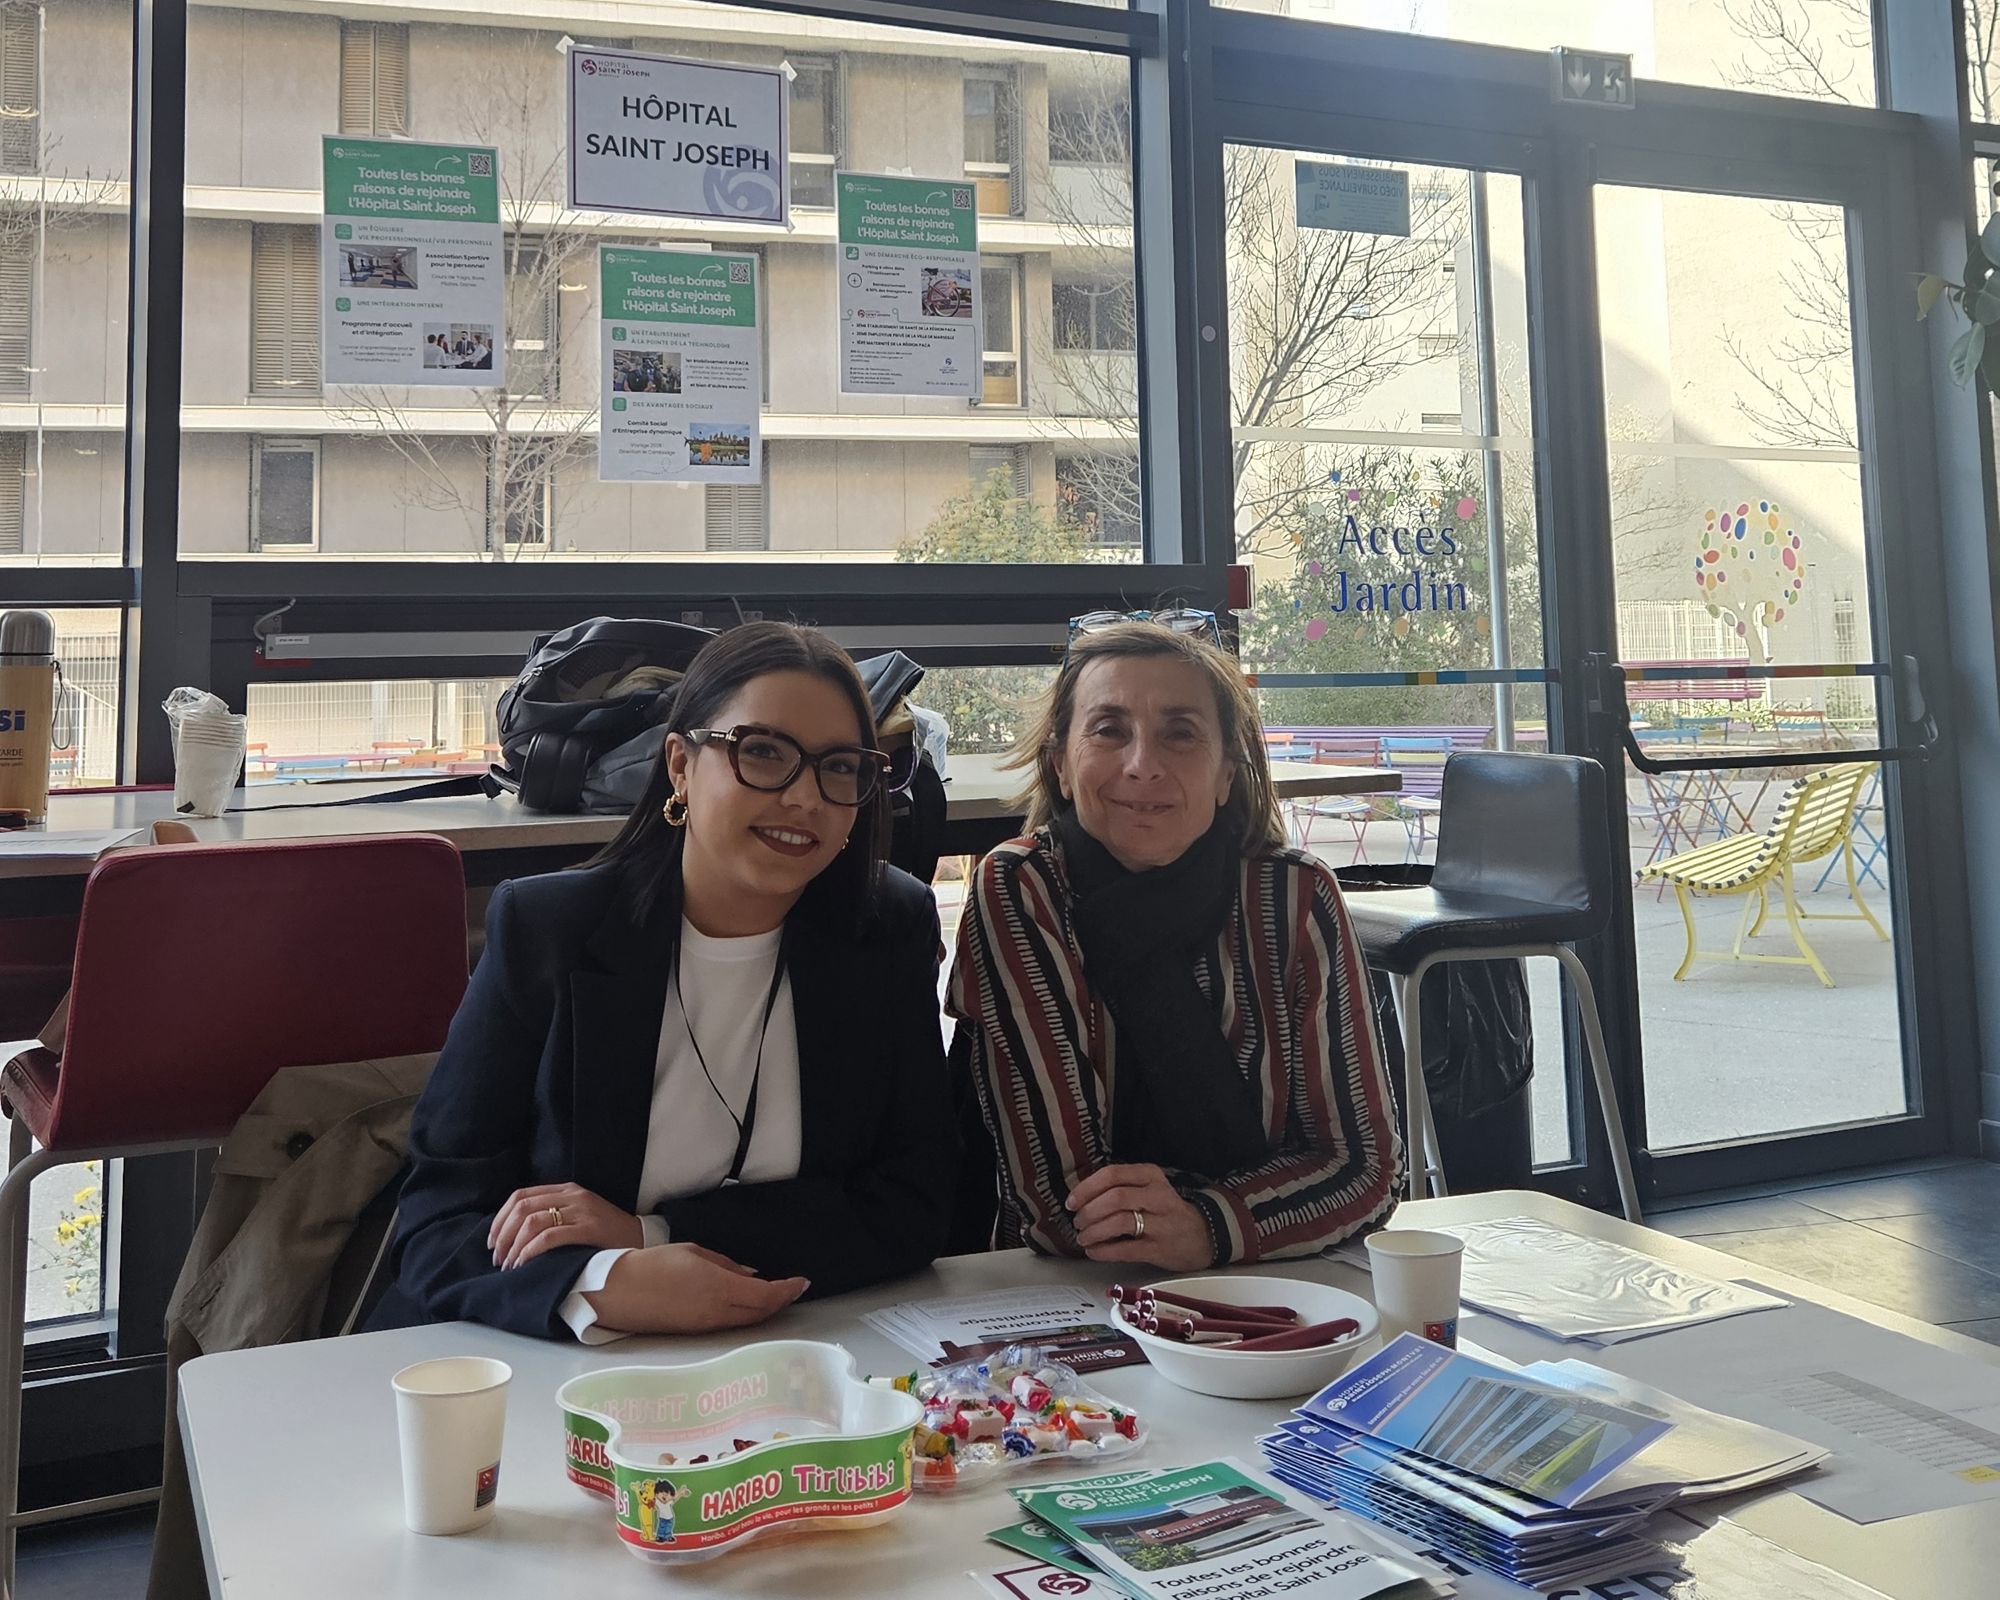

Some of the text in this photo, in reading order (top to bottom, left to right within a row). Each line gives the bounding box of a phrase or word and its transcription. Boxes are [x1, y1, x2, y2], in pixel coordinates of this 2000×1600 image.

[622, 94, 738, 128] HÔPITAL
[586, 133, 770, 171] SAINT JOSEPH
[358, 167, 465, 184] Toutes les bonnes
[354, 183, 471, 200] raisons de rejoindre
[348, 197, 476, 216] l'Hôpital Saint Joseph
[864, 200, 950, 216] Toutes les bonnes
[862, 214, 954, 230] raisons de rejoindre
[858, 227, 960, 245] l'Hôpital Saint Joseph
[425, 252, 490, 263] Association Sportive
[454, 263, 486, 271] personnel
[631, 272, 727, 288] Toutes les bonnes
[627, 286, 732, 302] raisons de rejoindre
[622, 300, 736, 318] l'Hôpital Saint Joseph
[342, 320, 382, 330] Programme
[1338, 512, 1458, 556] Accès
[1331, 570, 1468, 613] Jardin
[792, 1460, 895, 1494] Tirlibibi
[701, 1470, 783, 1522] HARIBO
[793, 1505, 804, 1514] les
[804, 1504, 830, 1514] grands
[832, 1504, 840, 1512] et
[842, 1502, 852, 1512] les
[854, 1502, 874, 1512] petits
[1152, 1538, 1328, 1590] Toutes les bonnes
[1171, 1581, 1243, 1600] raisons
[1244, 1568, 1273, 1584] de
[1273, 1570, 1324, 1592] Saint
